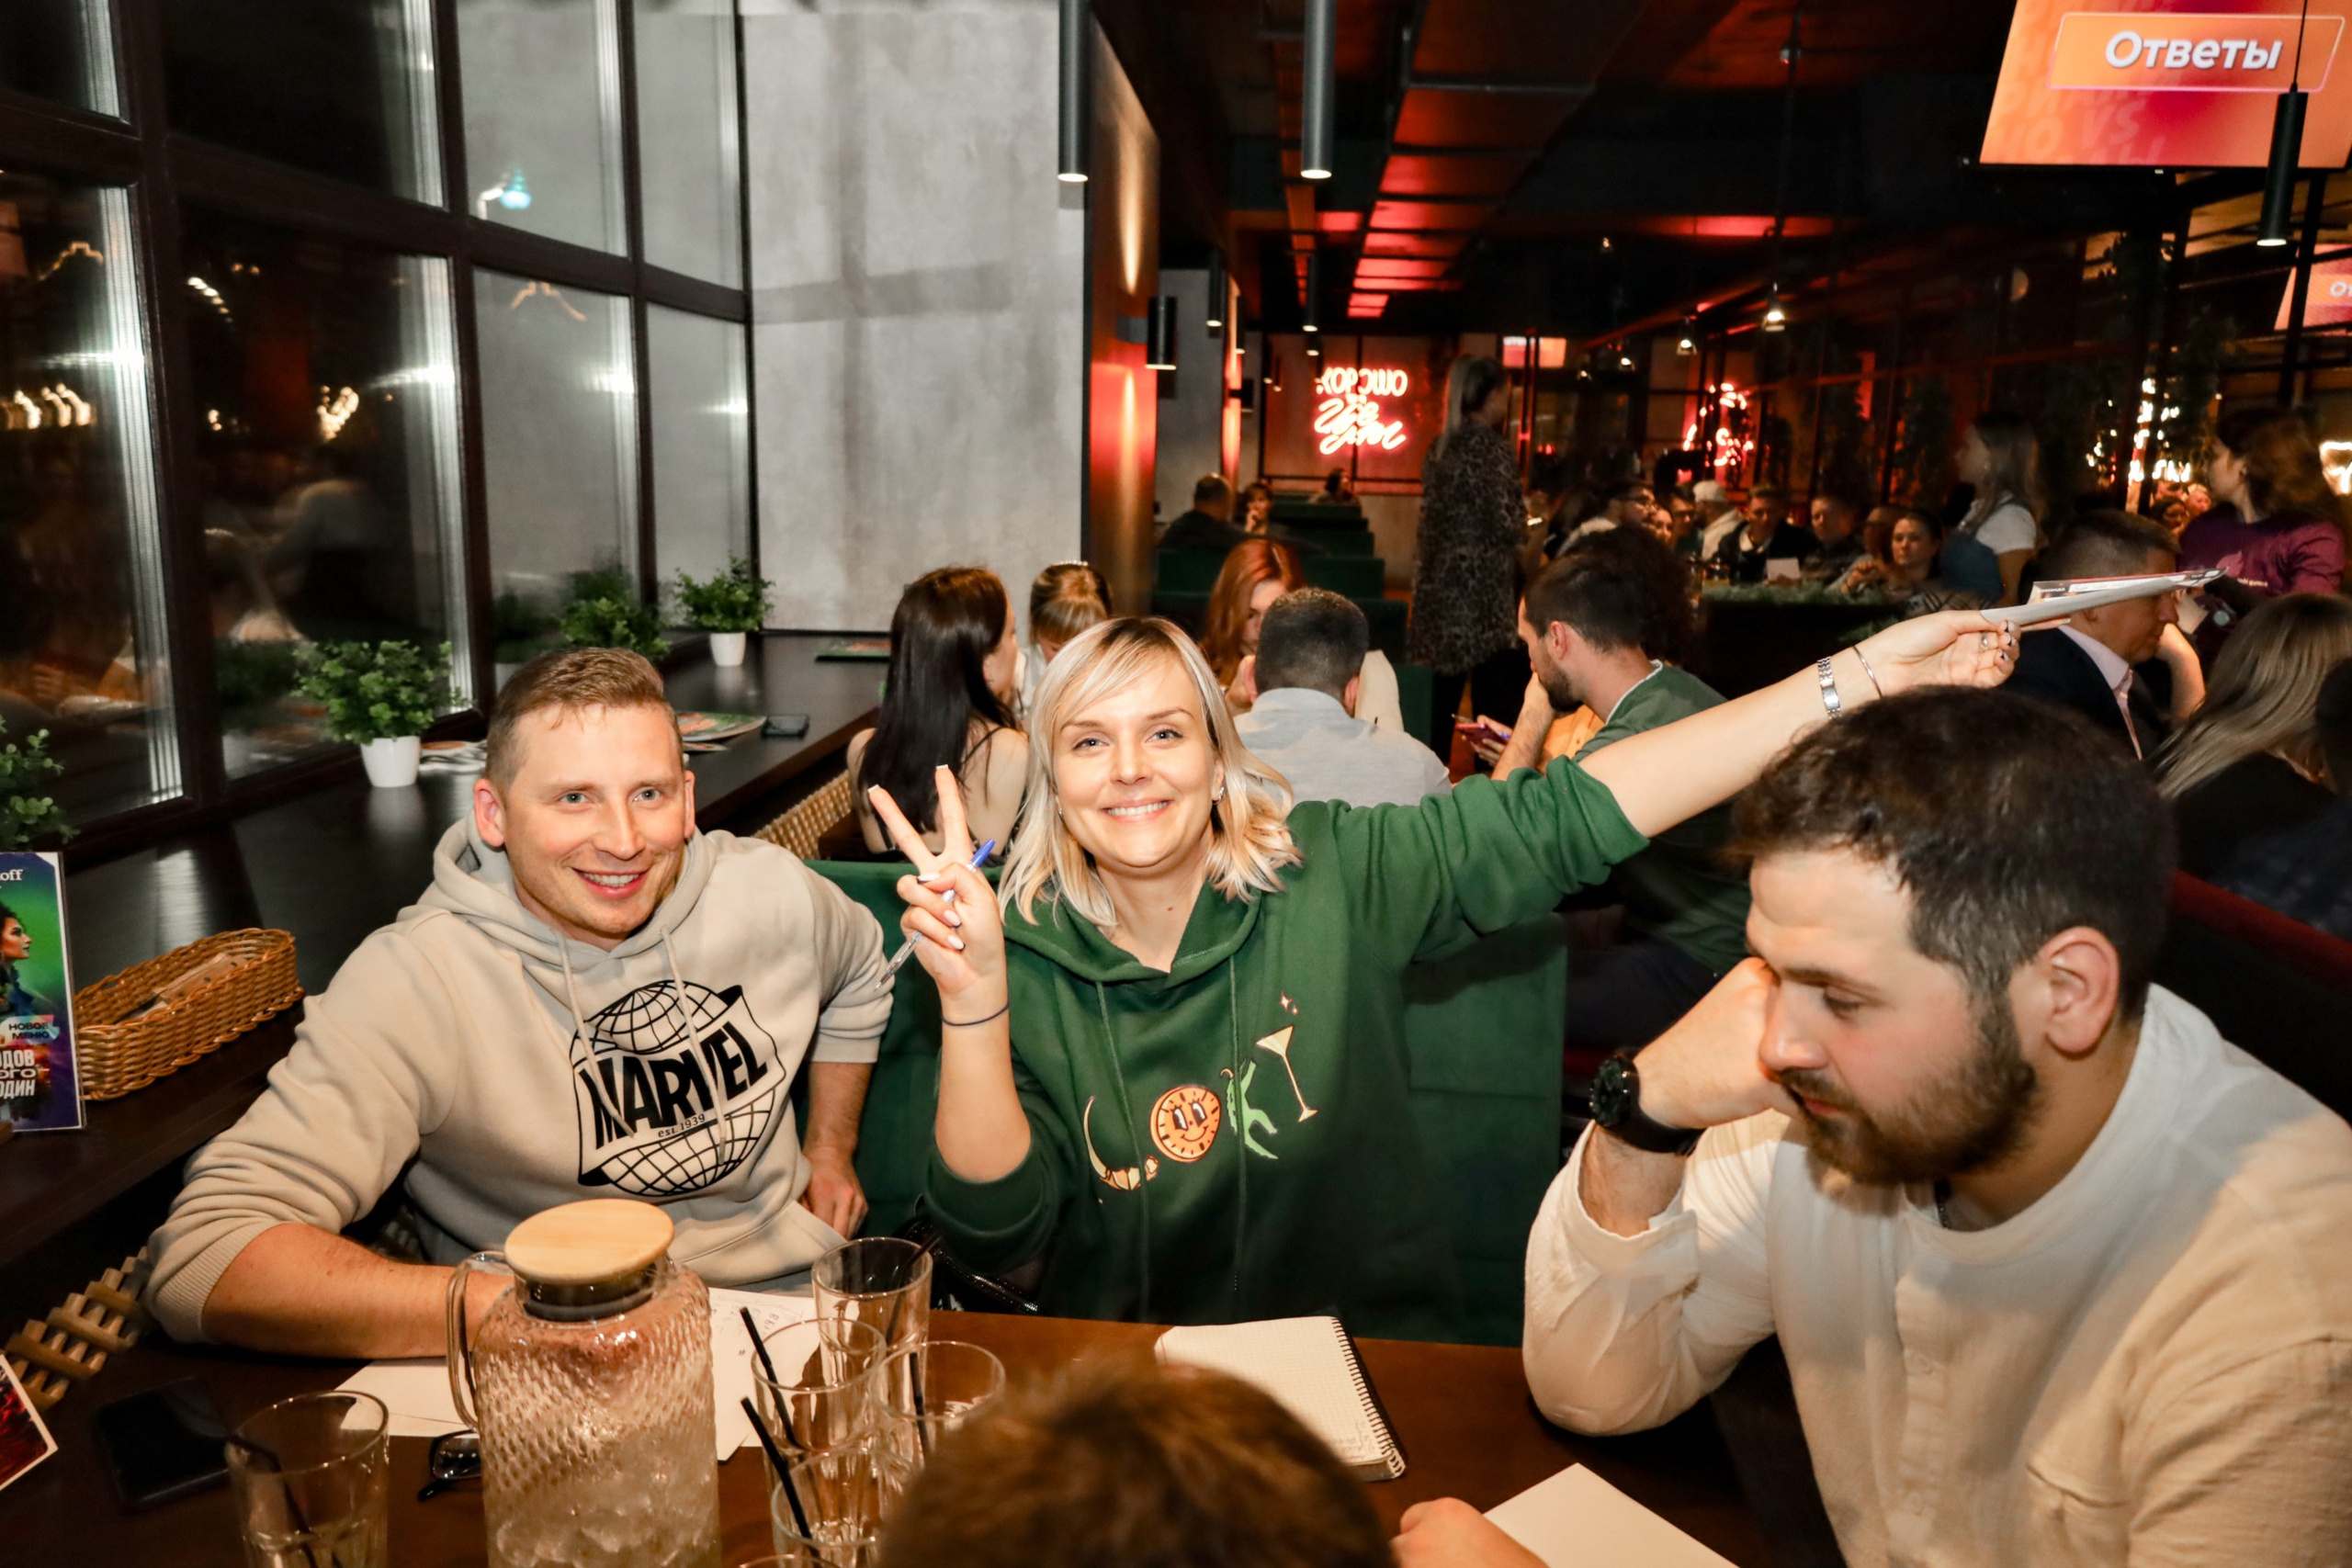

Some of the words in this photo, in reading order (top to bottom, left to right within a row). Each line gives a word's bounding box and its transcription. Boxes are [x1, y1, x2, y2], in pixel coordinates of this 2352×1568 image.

[2105, 30, 2283, 70] Ответы
[1315, 367, 1408, 397] ХОРОШО
[0, 868, 24, 881] off
[12, 1031, 51, 1040] МЕНЮ
[0, 1049, 35, 1070] ДОВ
[578, 1021, 768, 1150] MARVEL
[681, 1113, 706, 1131] 1939
